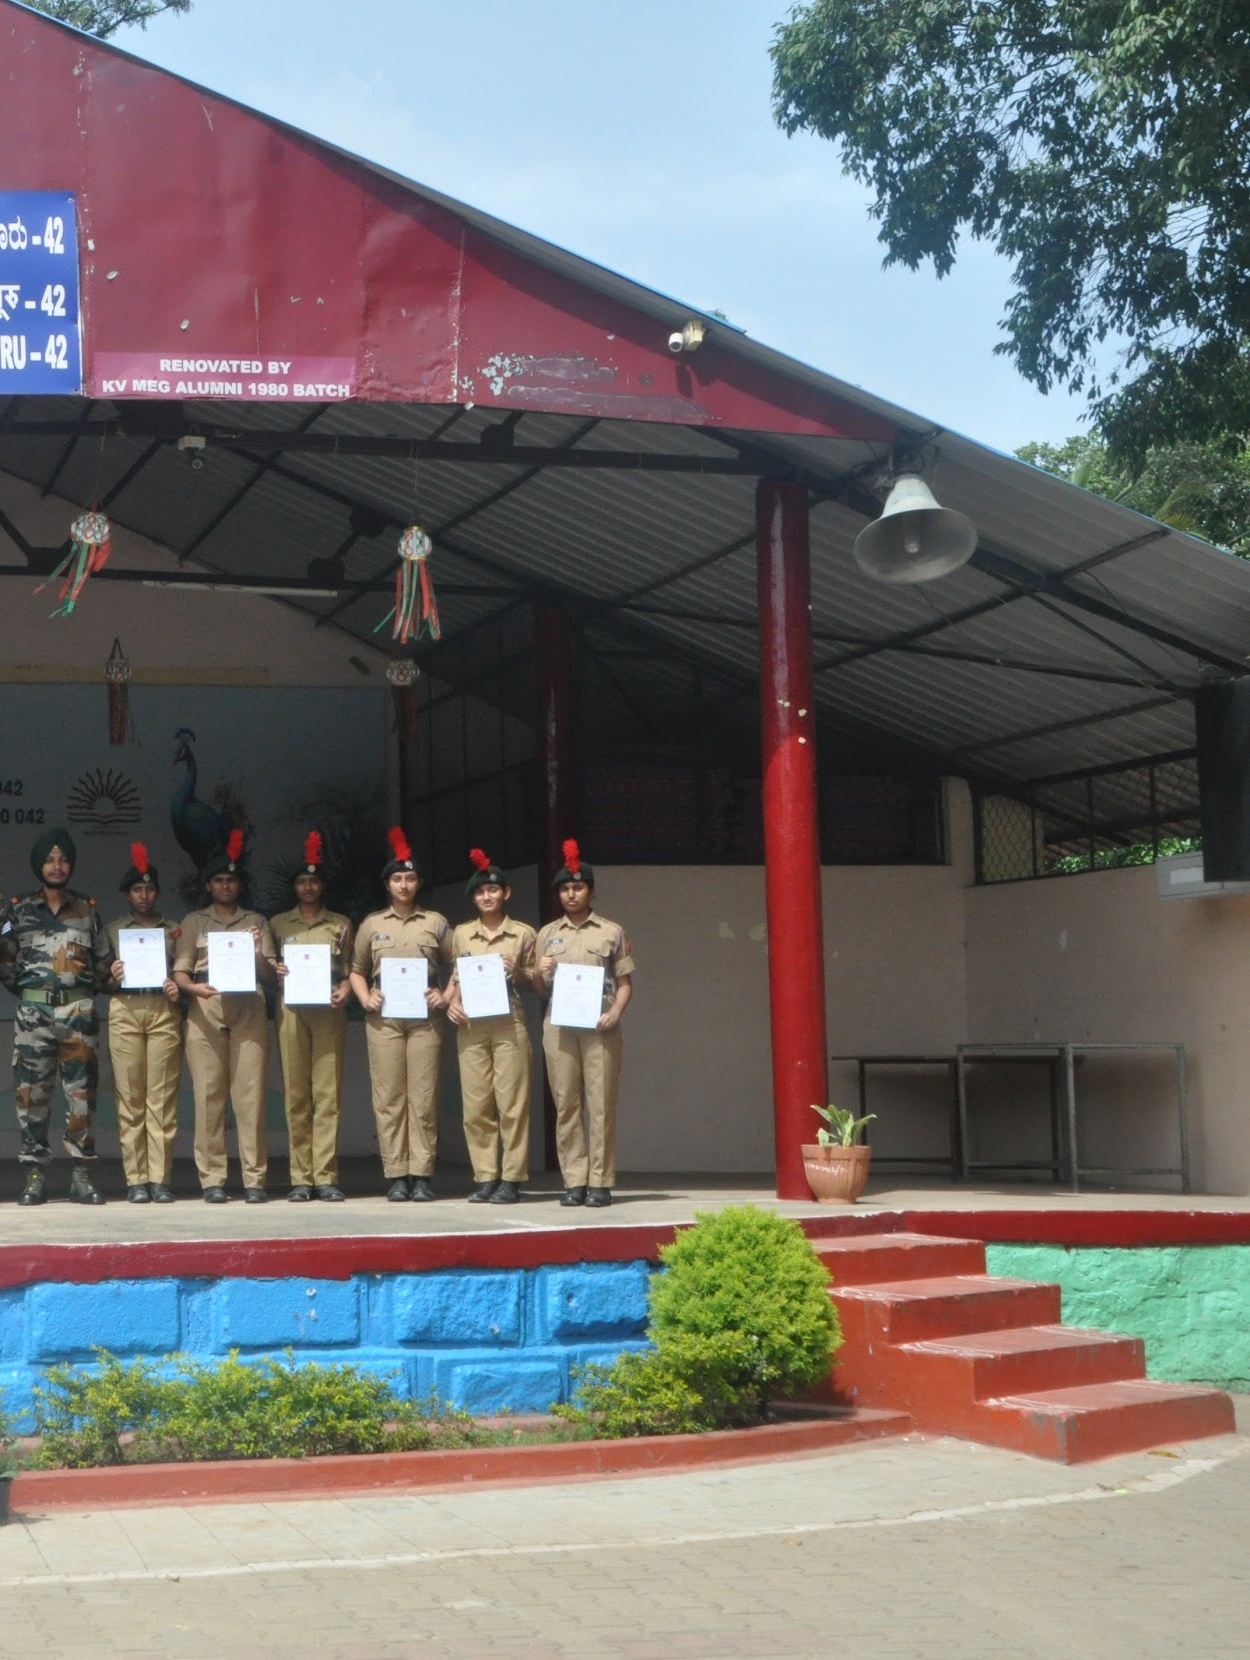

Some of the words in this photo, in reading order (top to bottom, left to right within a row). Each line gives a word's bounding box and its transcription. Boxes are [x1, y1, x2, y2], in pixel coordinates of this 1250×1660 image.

[160, 359, 263, 374] RENOVATED
[268, 361, 291, 374] BY
[102, 380, 127, 392] KV
[132, 380, 170, 393] MEG
[176, 381, 242, 395] ALUMNI
[248, 383, 288, 396] 1980
[293, 384, 350, 397] BATCH
[15, 808, 45, 825] 042
